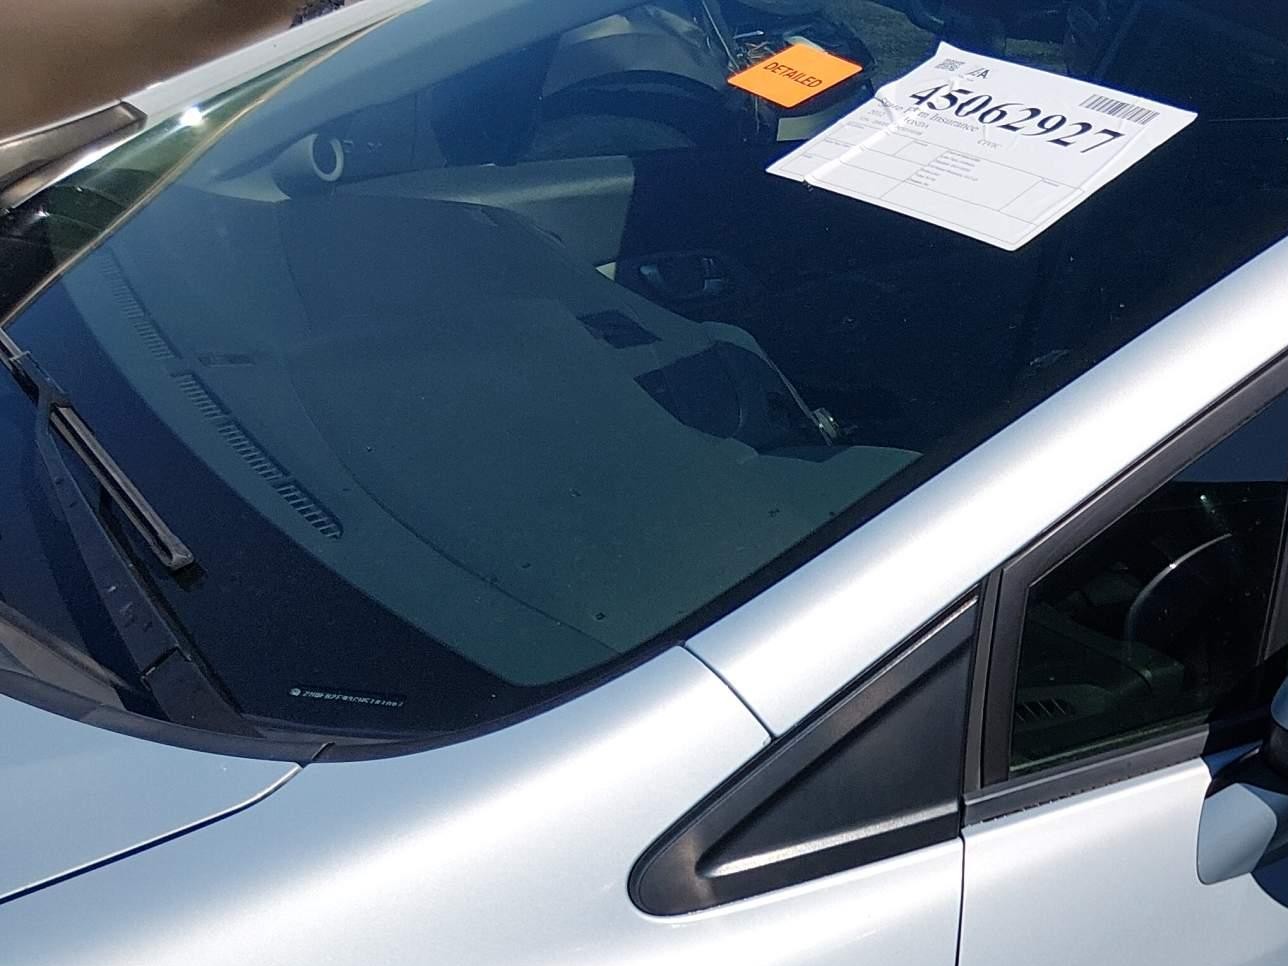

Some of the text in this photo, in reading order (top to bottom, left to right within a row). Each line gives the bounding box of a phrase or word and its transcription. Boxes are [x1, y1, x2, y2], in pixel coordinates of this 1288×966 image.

[763, 61, 823, 88] DETAILED
[909, 83, 1125, 154] 45062927
[929, 112, 980, 132] Insurance
